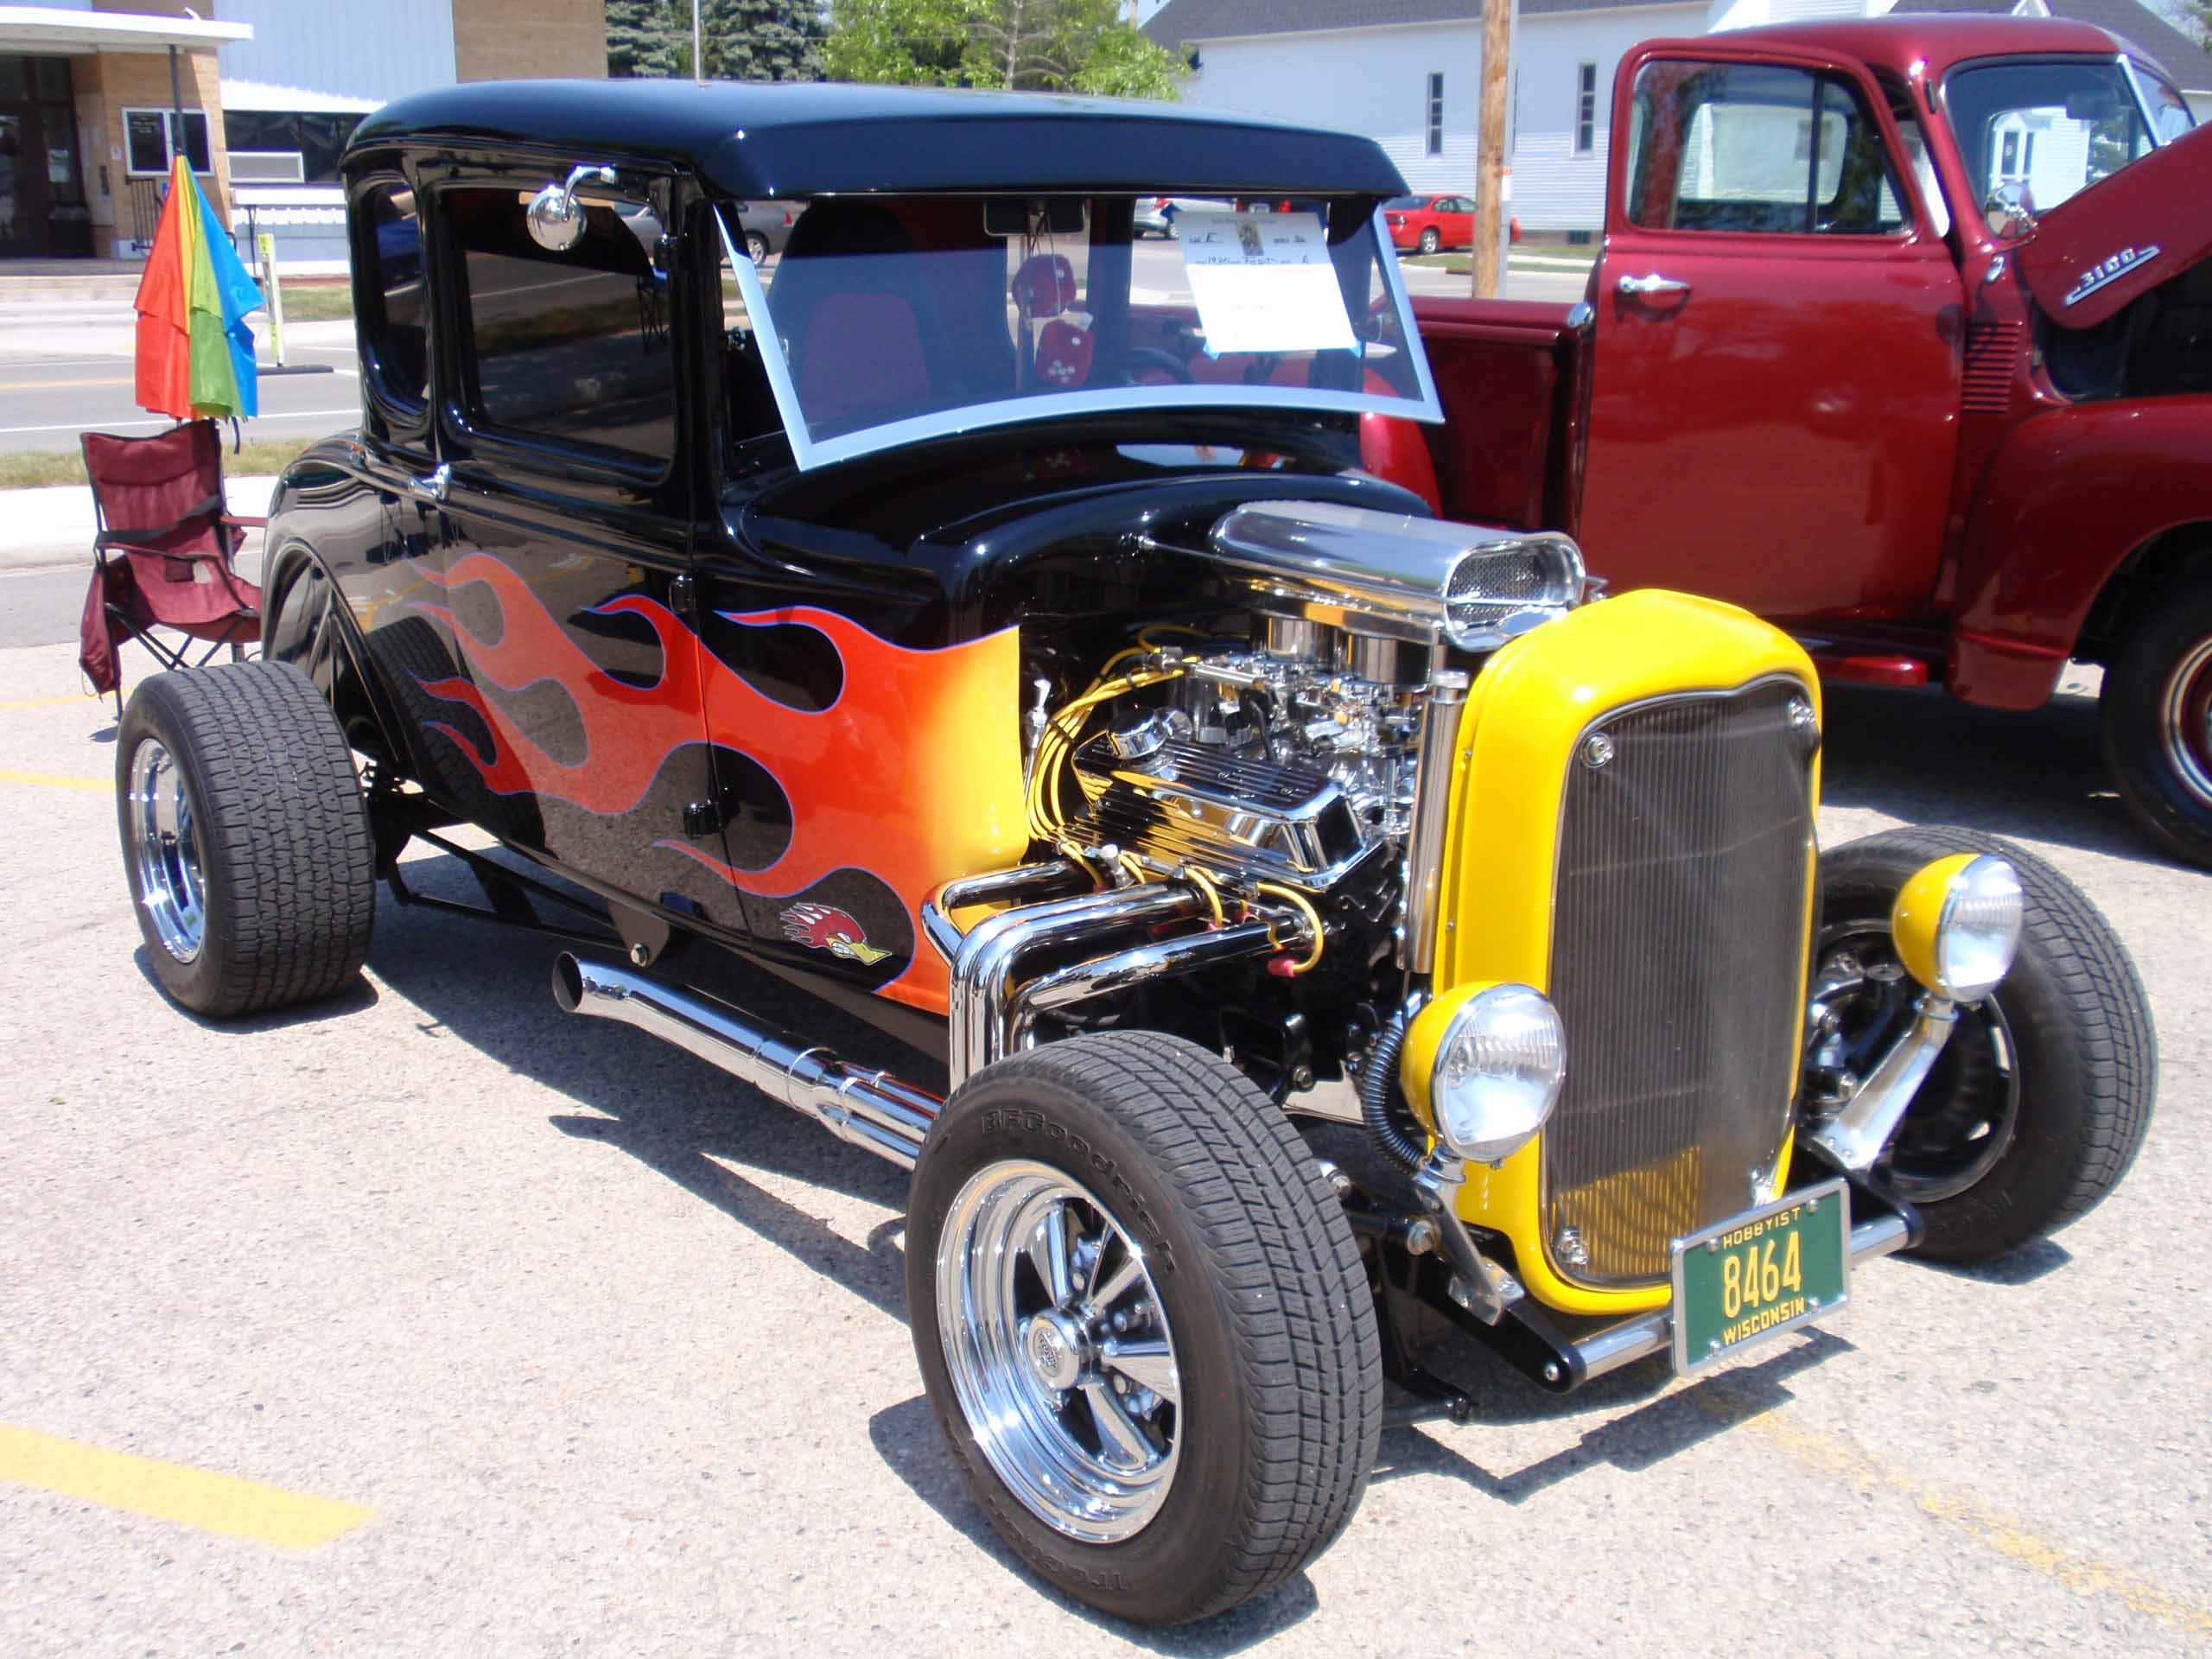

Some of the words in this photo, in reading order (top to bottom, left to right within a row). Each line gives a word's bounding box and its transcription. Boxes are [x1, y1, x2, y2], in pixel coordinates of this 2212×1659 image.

[1723, 1206, 1801, 1250] HOBBYIST
[1724, 1230, 1802, 1319] 8464
[1723, 1297, 1805, 1346] WISCONSIN
